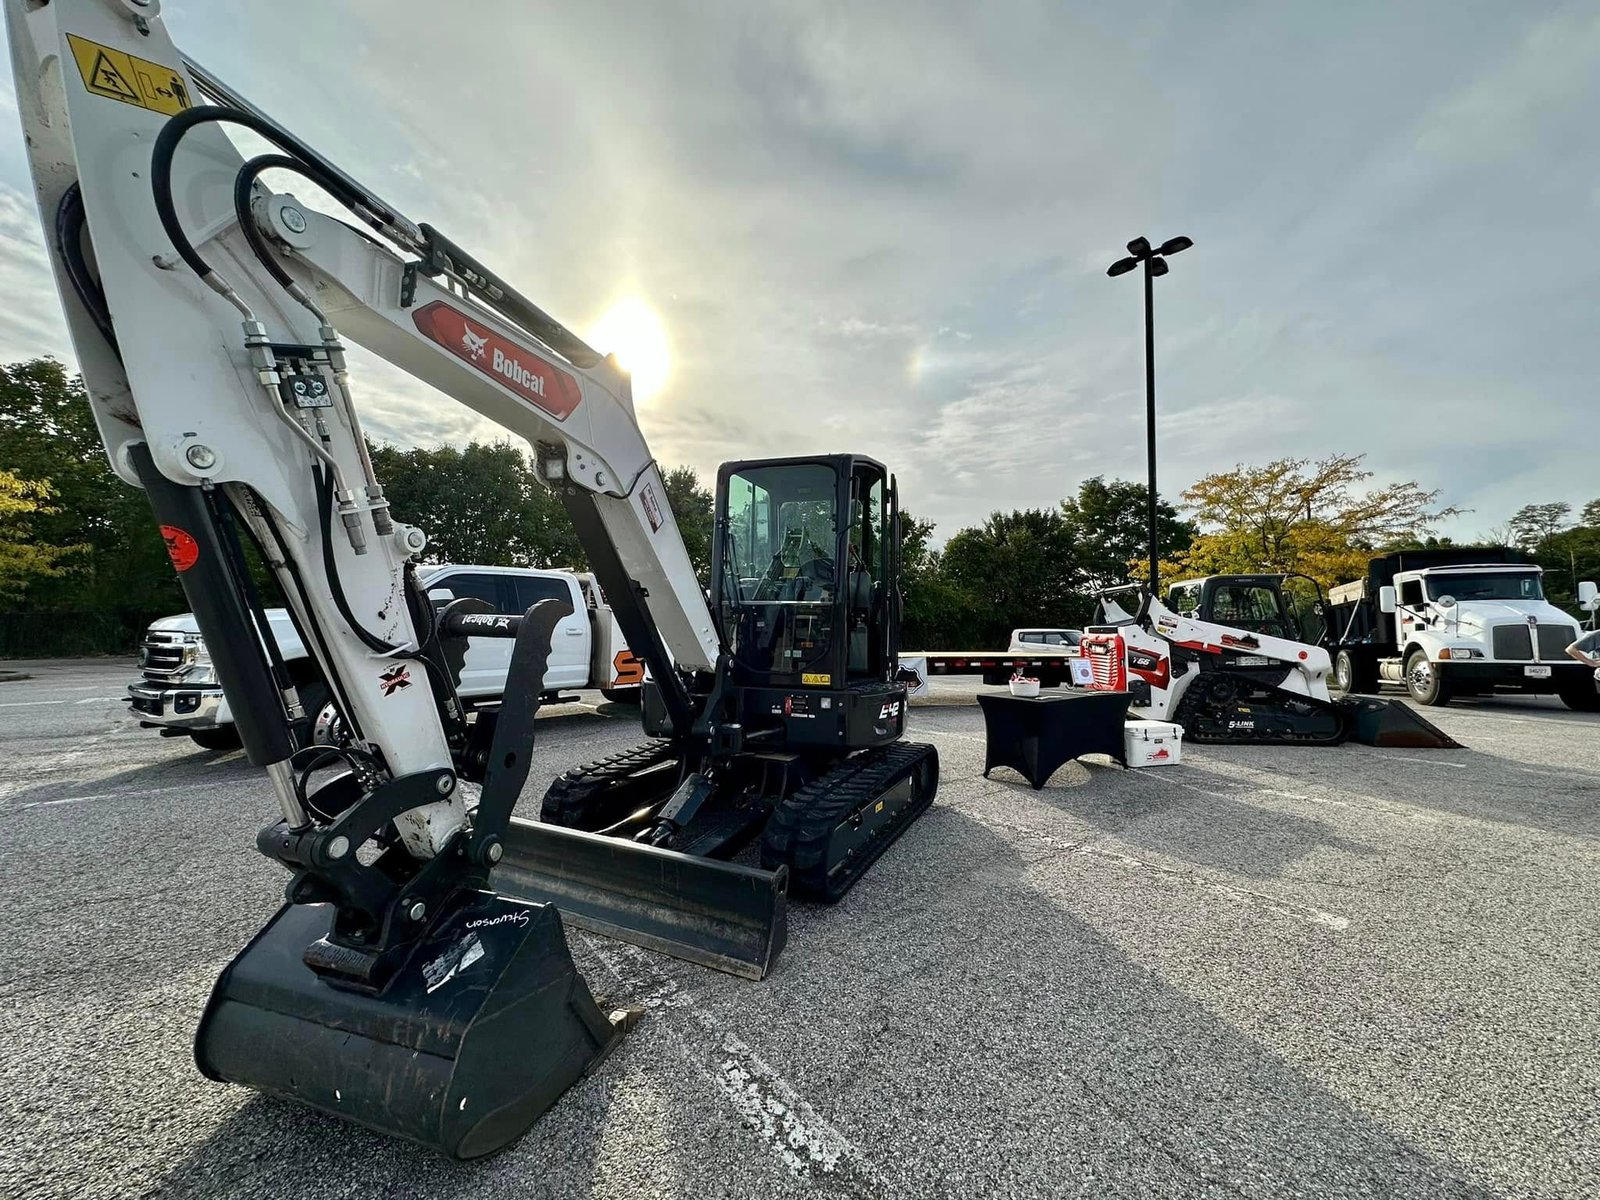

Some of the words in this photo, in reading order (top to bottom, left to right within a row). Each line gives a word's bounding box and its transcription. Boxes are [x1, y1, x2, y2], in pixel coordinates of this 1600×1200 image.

[492, 348, 546, 397] Bobcat
[461, 614, 496, 626] Bobcat
[878, 701, 900, 720] E42
[1228, 720, 1255, 729] 5-LINK
[466, 909, 531, 928] Stevenson
